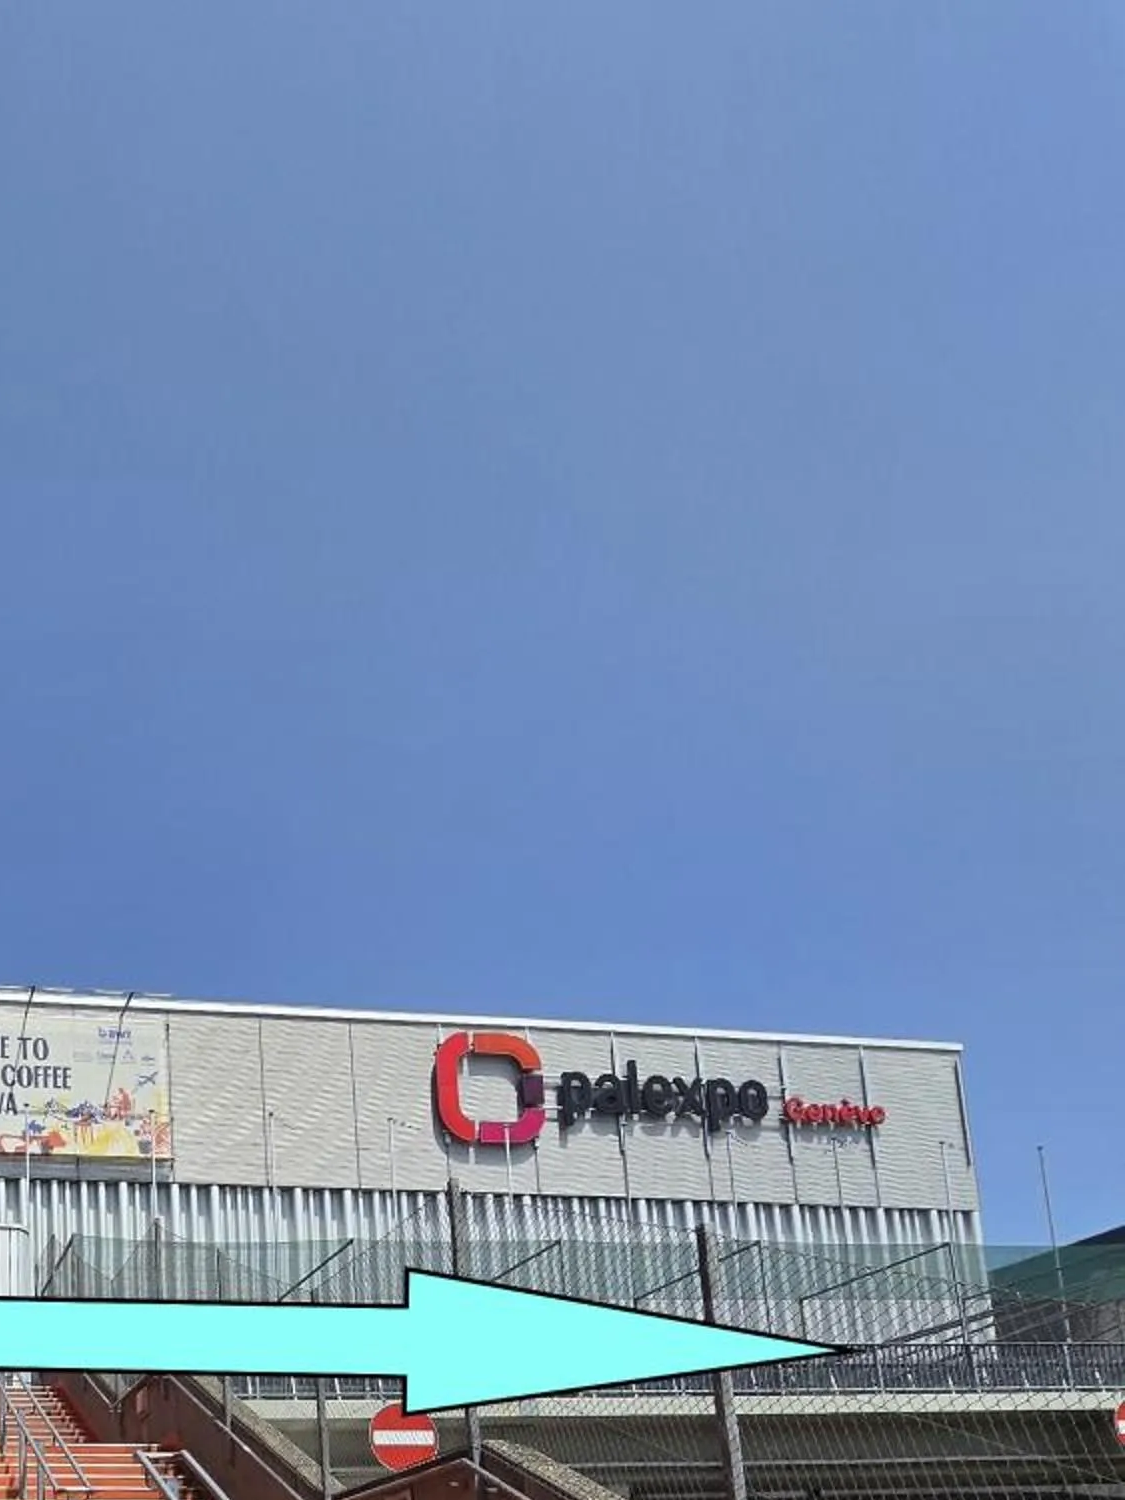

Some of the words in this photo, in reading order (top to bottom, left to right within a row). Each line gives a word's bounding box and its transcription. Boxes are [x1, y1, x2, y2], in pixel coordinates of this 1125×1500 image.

[17, 1037, 50, 1061] TO
[1, 1064, 72, 1090] COFFEE
[557, 1060, 768, 1132] palexpo
